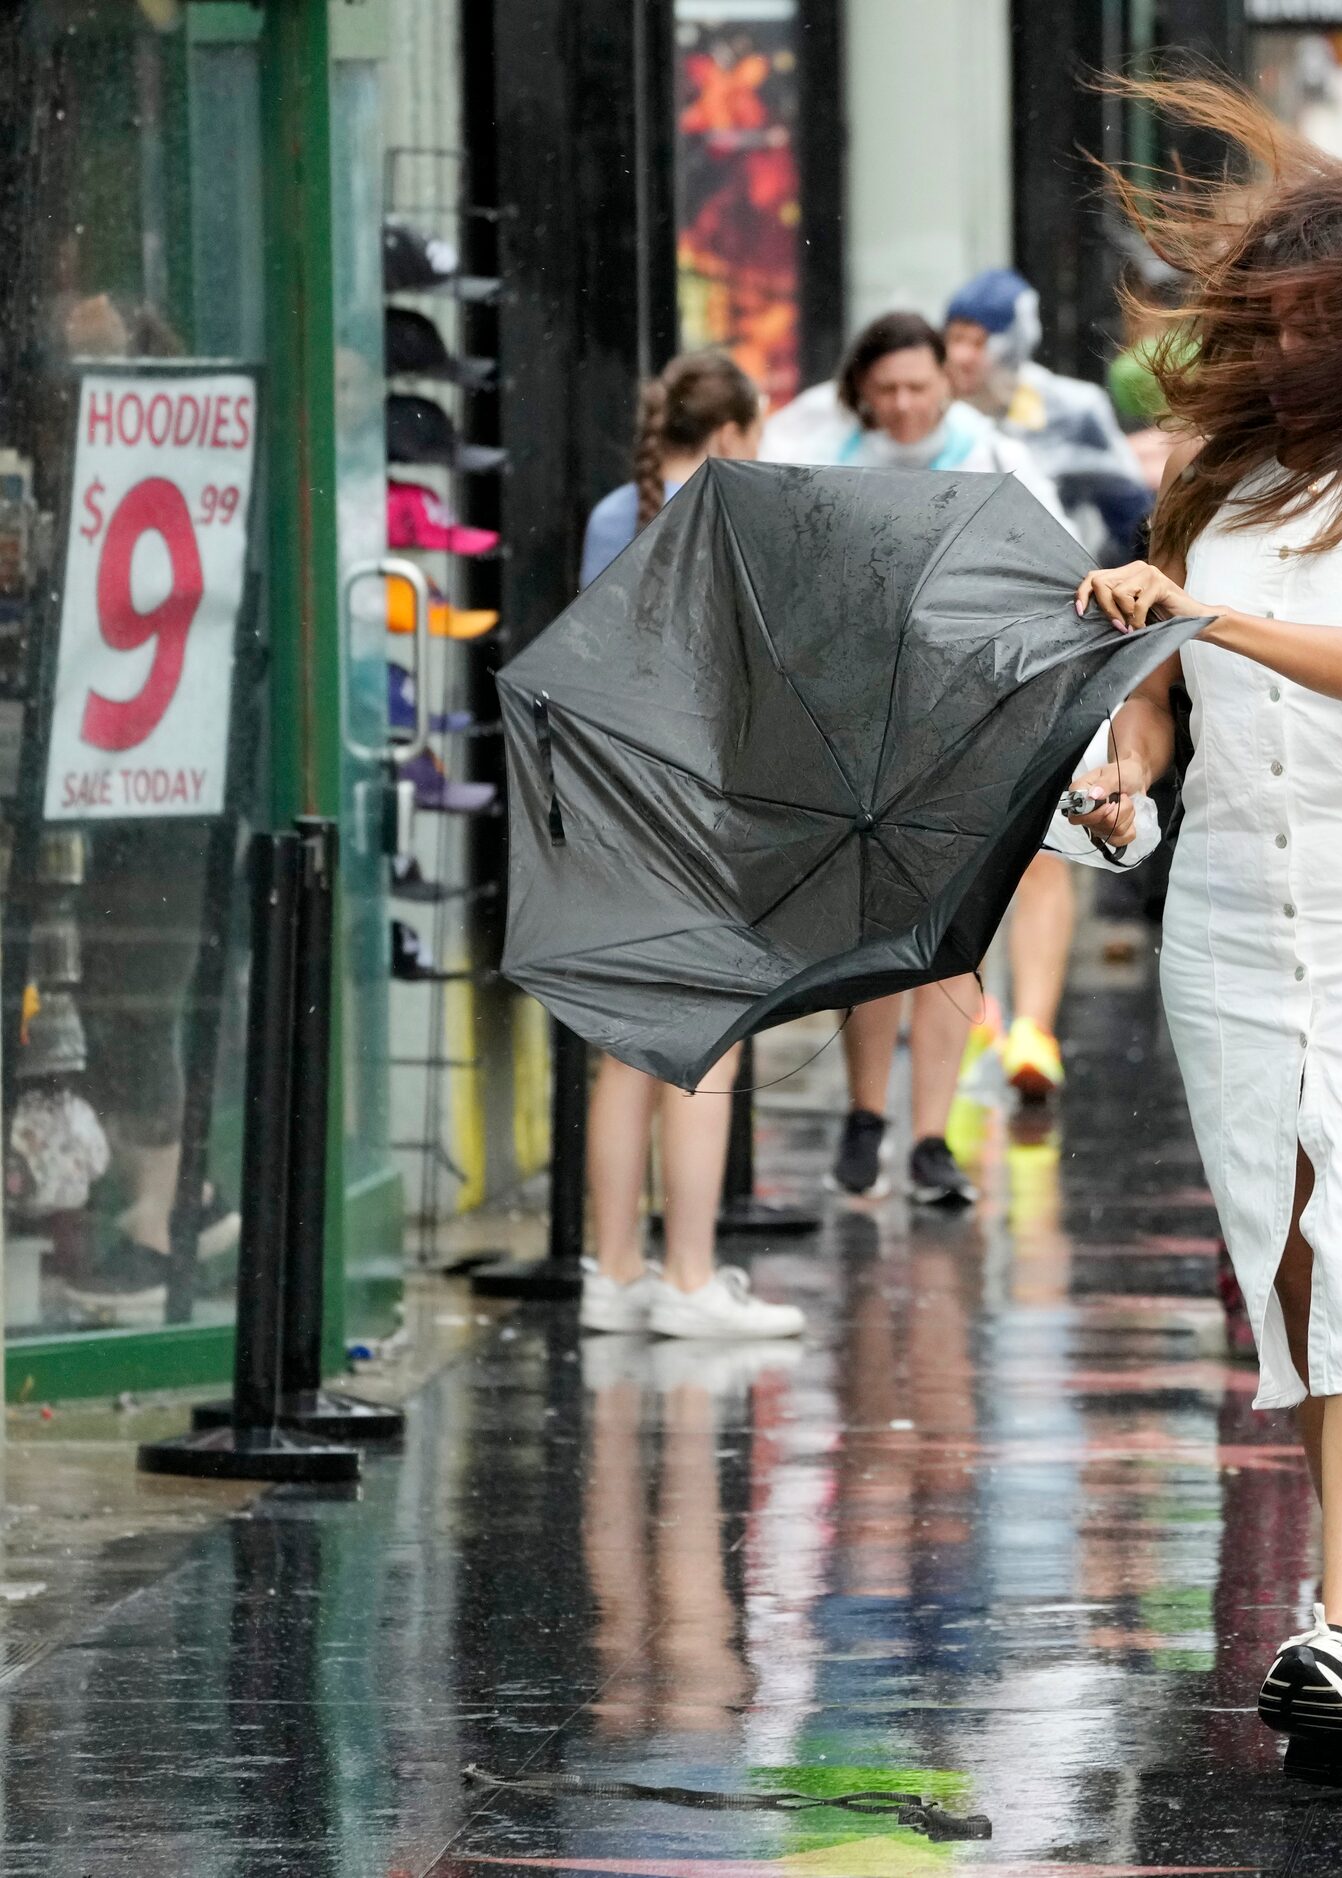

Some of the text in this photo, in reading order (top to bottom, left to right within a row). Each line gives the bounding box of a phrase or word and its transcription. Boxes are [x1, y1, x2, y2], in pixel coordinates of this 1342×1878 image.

[87, 391, 251, 449] HOODIES
[61, 767, 206, 808] SALE TODAY
